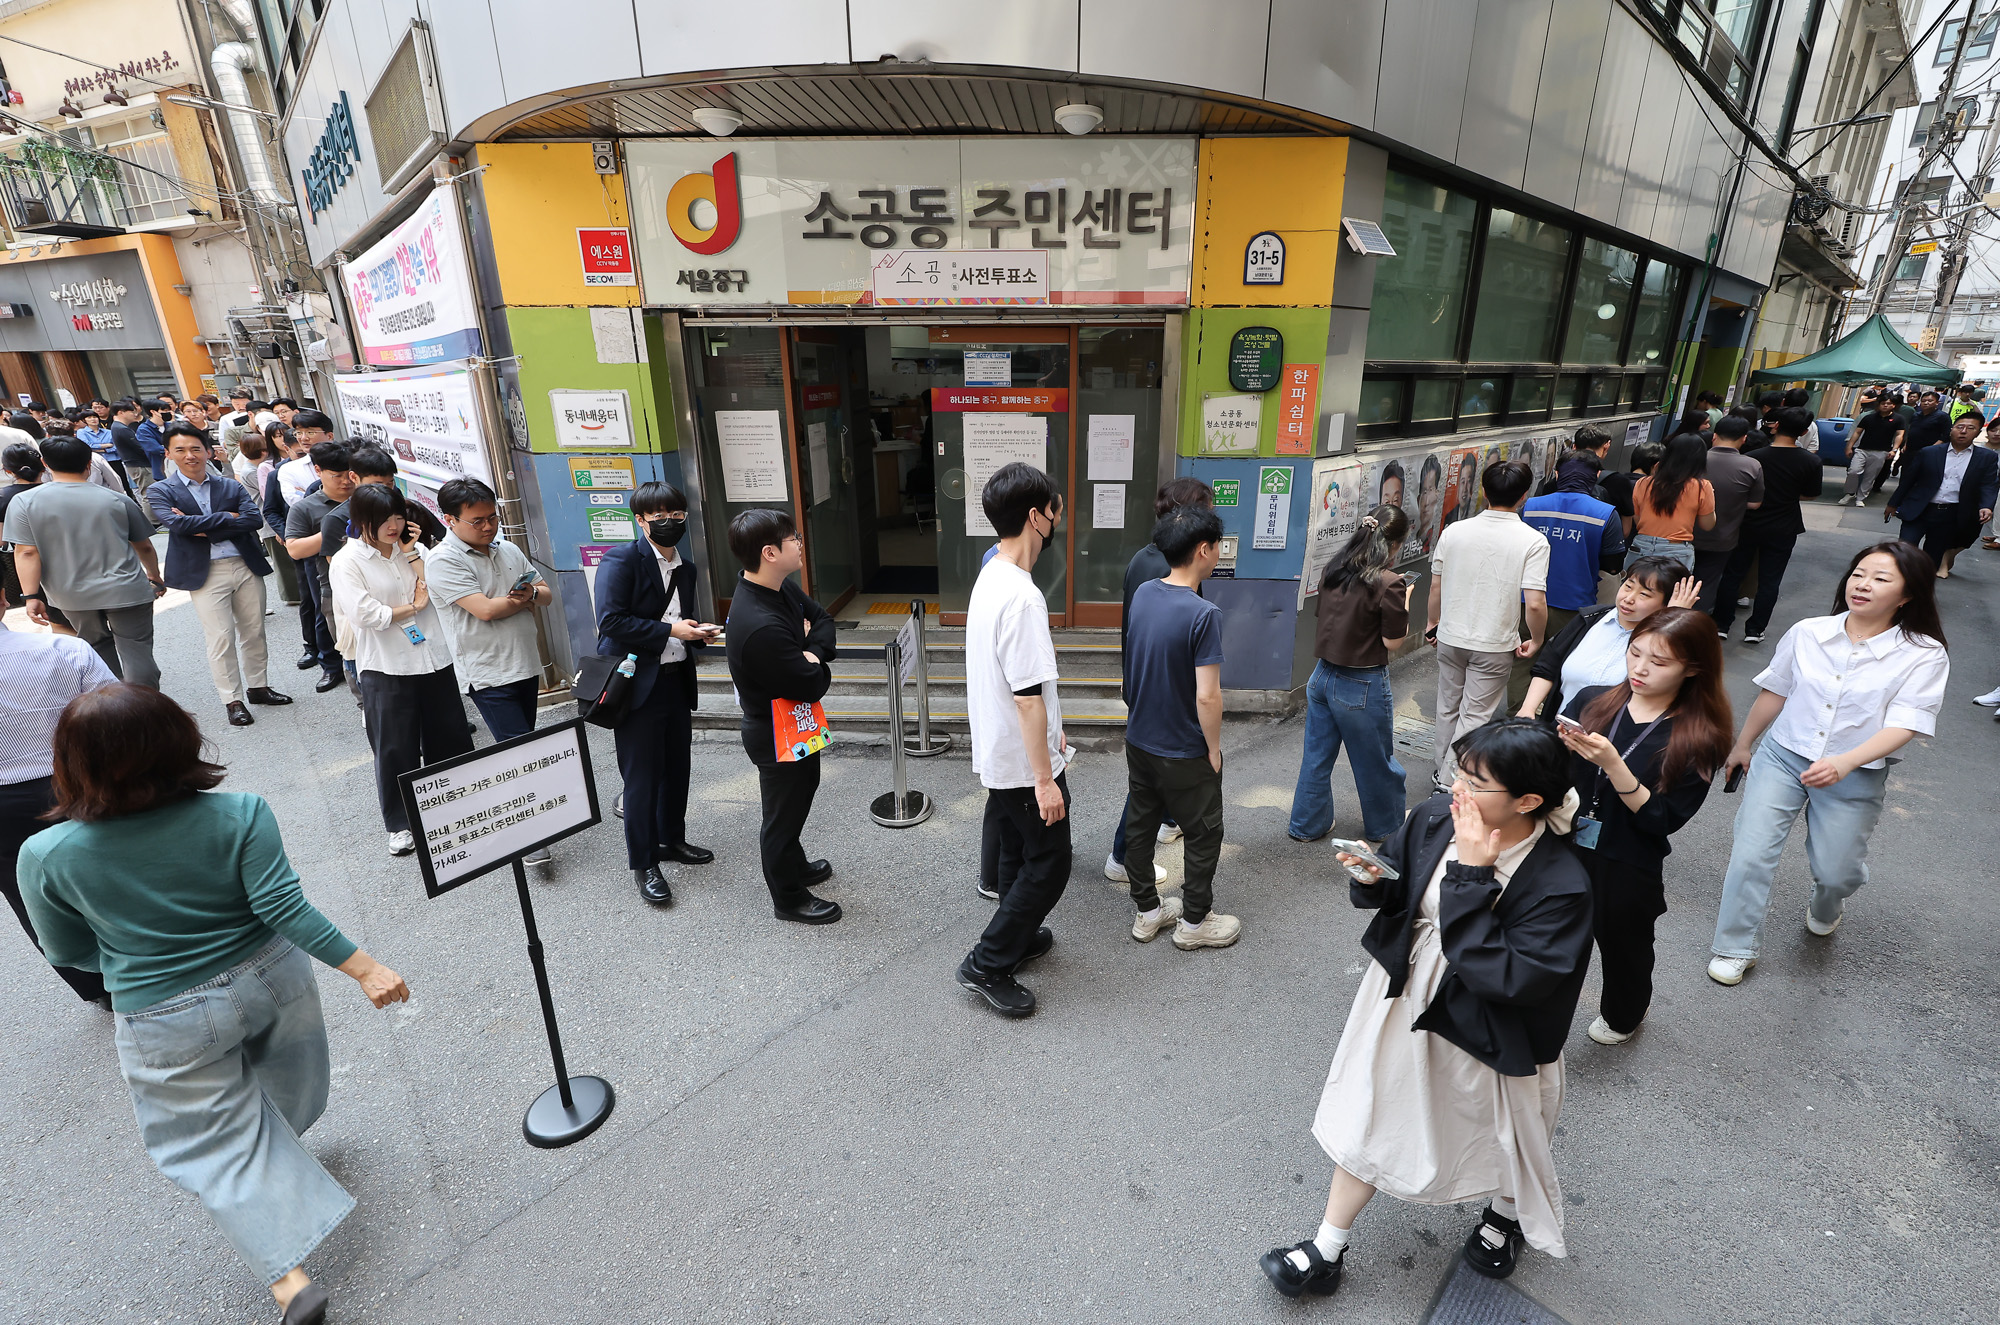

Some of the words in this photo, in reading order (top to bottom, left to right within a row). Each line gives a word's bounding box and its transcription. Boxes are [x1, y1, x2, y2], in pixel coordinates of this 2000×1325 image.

[802, 189, 955, 249] 소공동
[968, 188, 1173, 250] 주민센터
[590, 244, 623, 260] 에스원
[1250, 250, 1280, 265] 31-5
[586, 275, 614, 284] SECOM
[676, 269, 750, 293] 서울중구
[959, 267, 1038, 286] 사전투표소
[61, 277, 119, 310] 수요미식회
[88, 311, 124, 331] 방송맛집
[949, 395, 980, 404] 하나되는
[982, 395, 1000, 405] 중구,
[1001, 395, 1032, 404] 함께하는
[1033, 395, 1049, 404] 중구
[1287, 368, 1309, 437] 한파쉼터
[564, 408, 619, 424] 동네배움터
[1220, 409, 1243, 417] 소공동
[1206, 420, 1258, 429] 청소년문화센터
[1266, 494, 1279, 536] 무더위쉼터
[1316, 526, 1339, 541] 선거벽보
[1339, 521, 1356, 536] 주의문
[1402, 538, 1424, 560] 김문수
[415, 777, 451, 795] 여기는
[418, 787, 467, 811] 관외(중구
[470, 778, 492, 792] 거주
[495, 768, 519, 784] 이외)
[523, 747, 578, 773] 대기줄입니다.
[426, 825, 450, 841] 관내
[455, 792, 537, 830] 거주민(중구민)은
[430, 840, 454, 855] 바로
[458, 807, 535, 844] 투표소(주민센터
[539, 794, 568, 812] 4층)로
[434, 850, 472, 870] 가세요.
